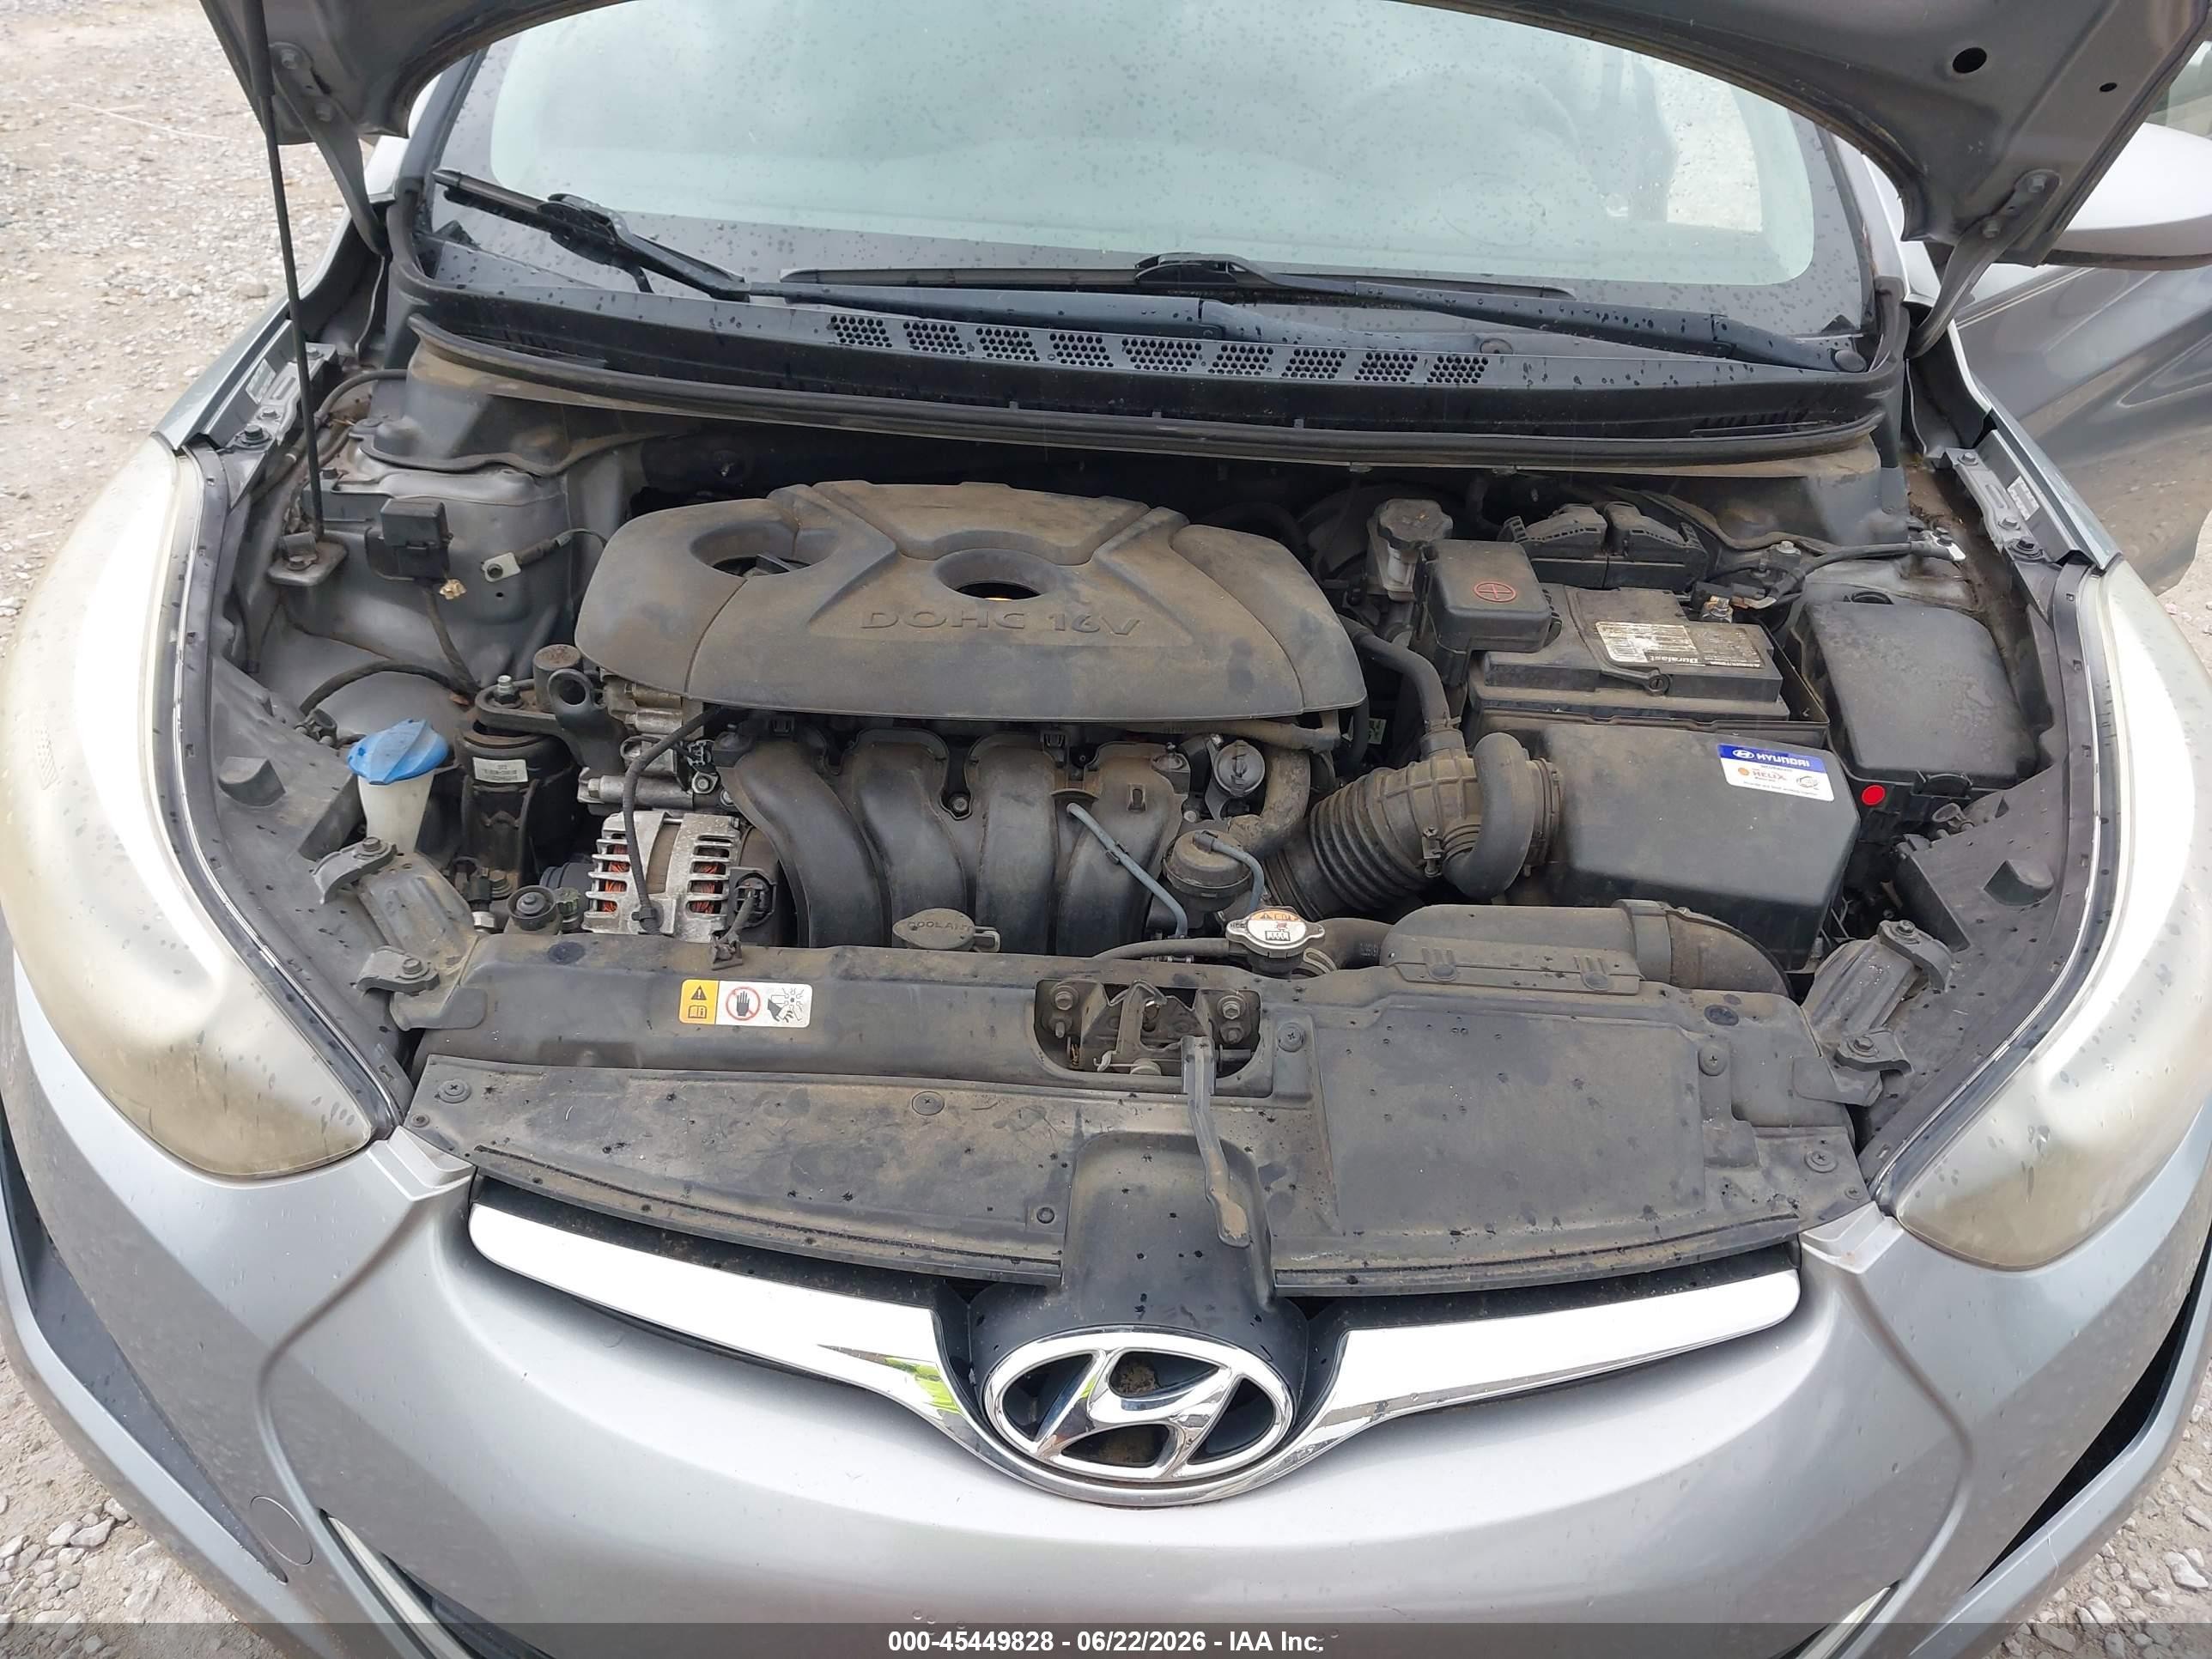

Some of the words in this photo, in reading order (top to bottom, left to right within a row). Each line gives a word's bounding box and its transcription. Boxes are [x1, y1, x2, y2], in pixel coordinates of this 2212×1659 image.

[860, 610, 1025, 629] DOHC
[1048, 612, 1140, 635] 16V
[1649, 655, 1698, 665] Duralast
[1755, 752, 1810, 768] HYUNDAI
